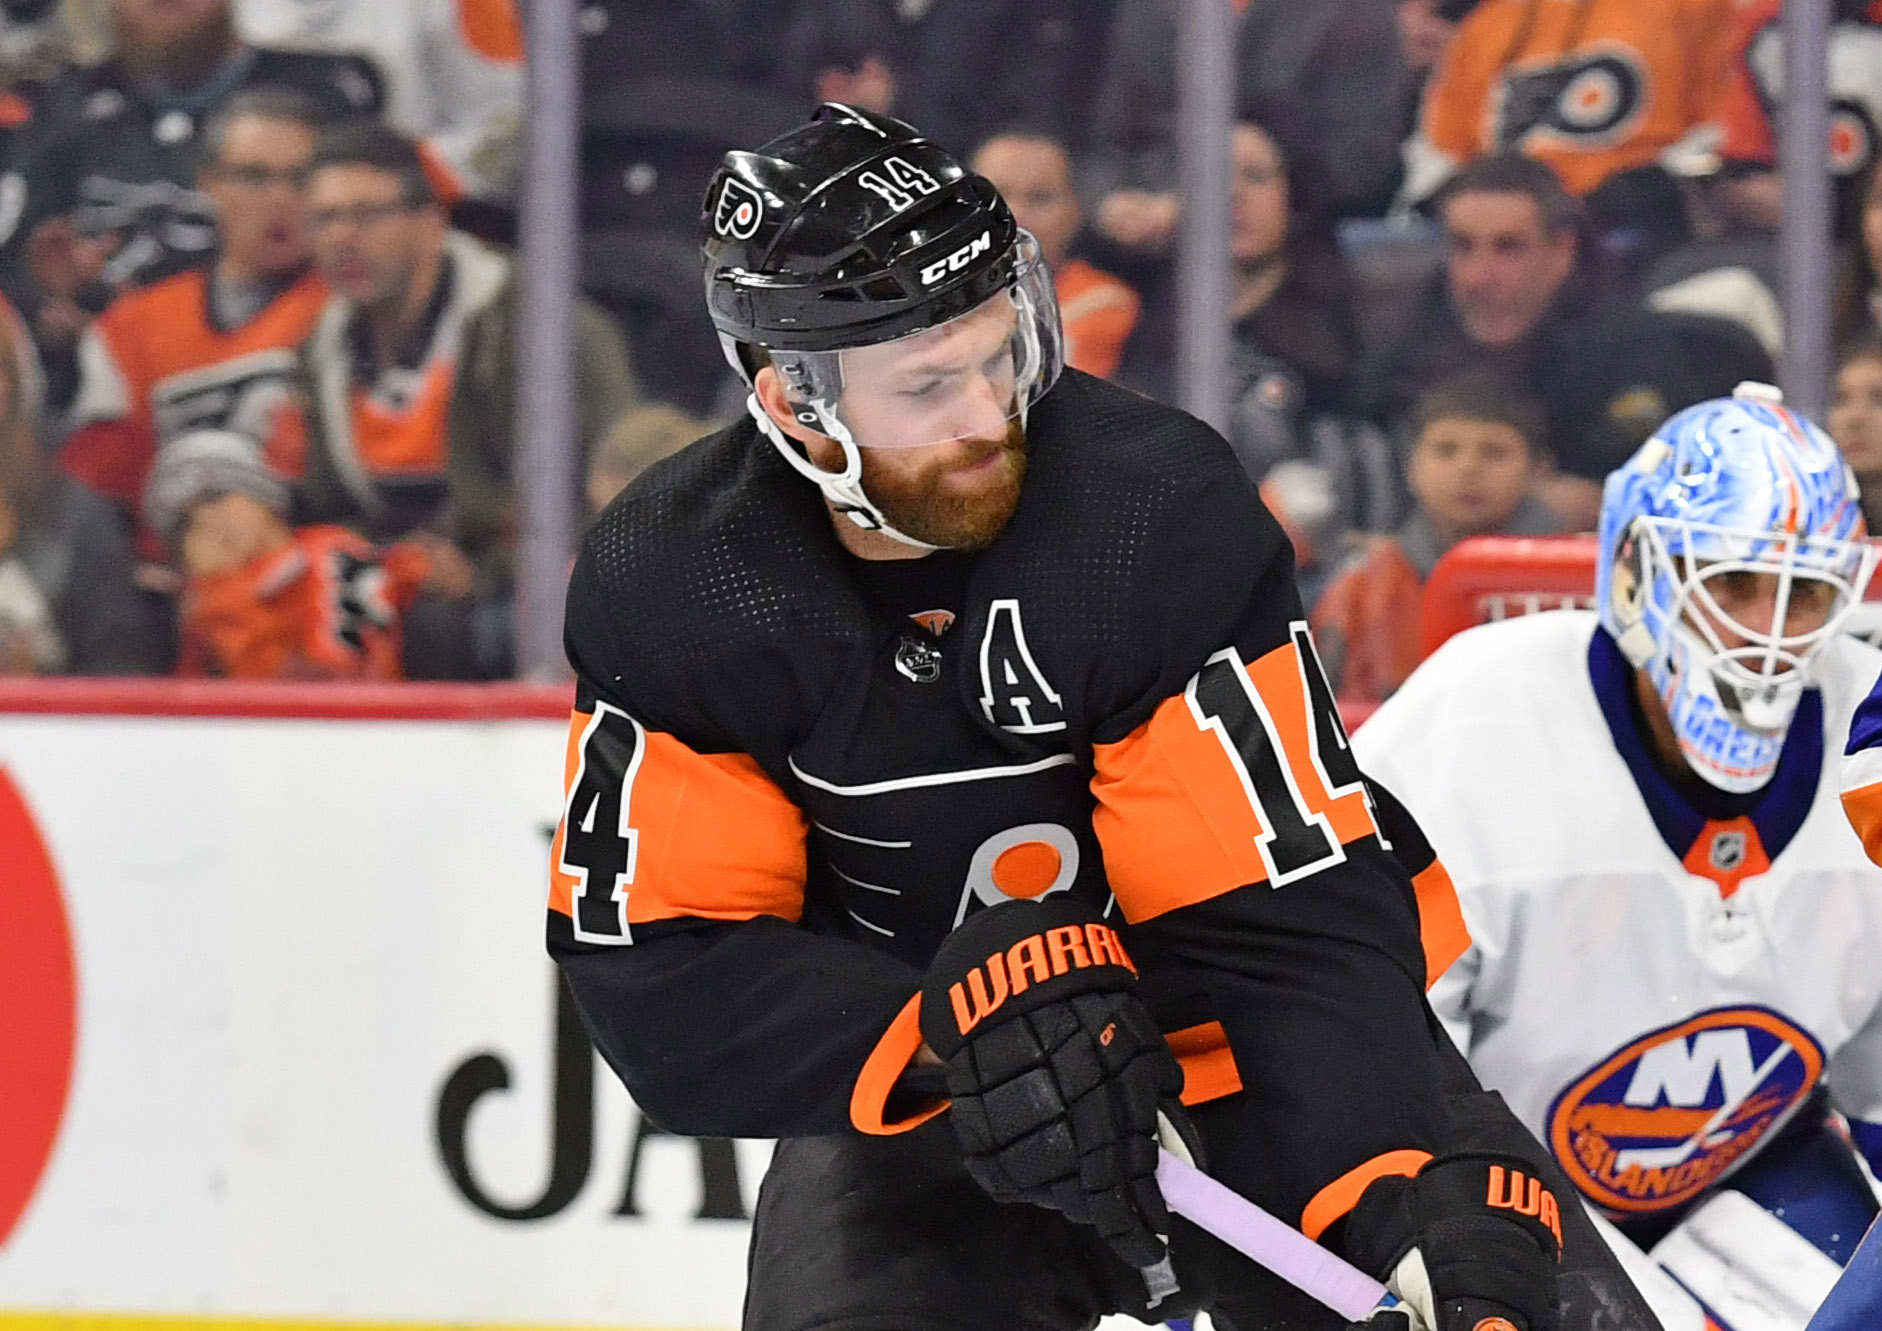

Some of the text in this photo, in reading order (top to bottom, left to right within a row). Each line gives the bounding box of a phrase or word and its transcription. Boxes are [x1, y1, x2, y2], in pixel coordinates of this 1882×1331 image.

[858, 156, 941, 212] 14
[919, 230, 991, 285] CCM
[979, 599, 1067, 734] A
